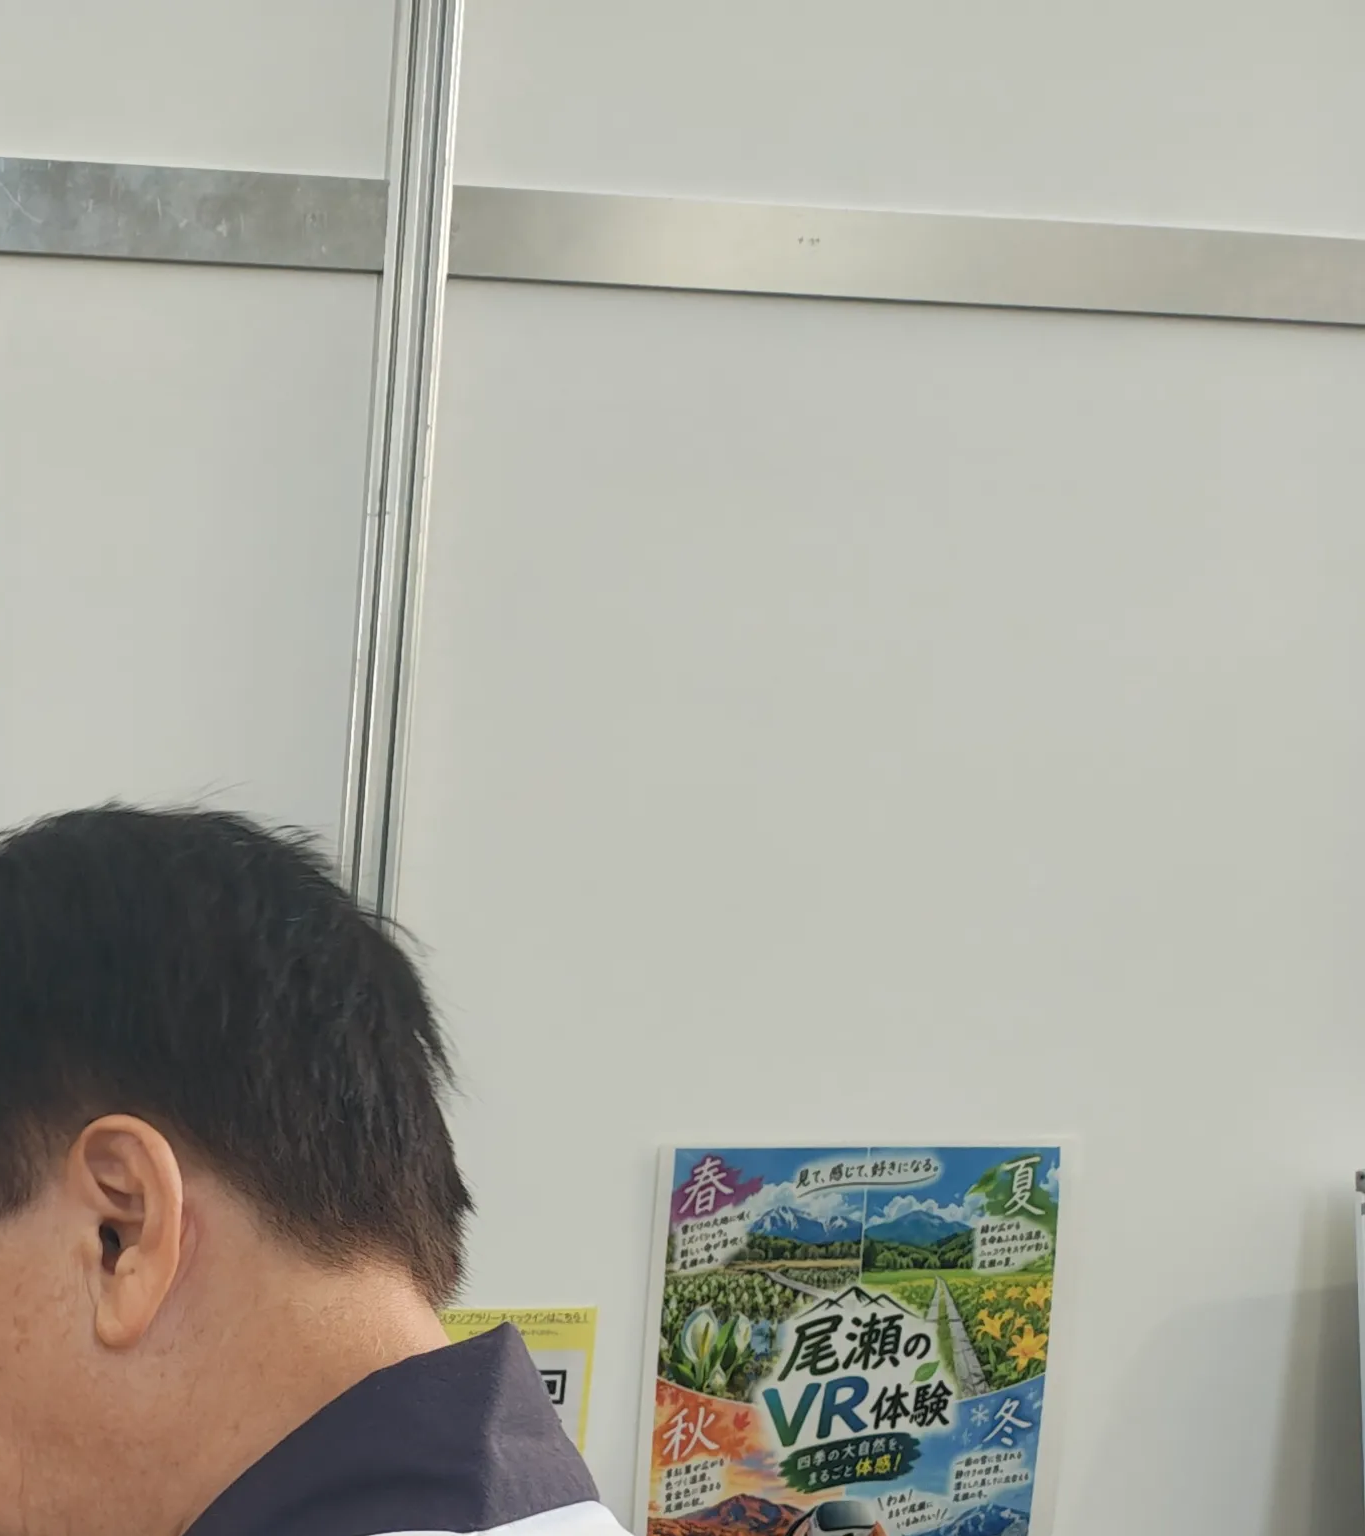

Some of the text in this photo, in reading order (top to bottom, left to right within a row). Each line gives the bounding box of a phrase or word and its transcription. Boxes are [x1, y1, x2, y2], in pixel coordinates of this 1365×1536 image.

[679, 1157, 734, 1215] 春
[1005, 1155, 1045, 1216] 夏
[778, 1313, 931, 1381] 尾瀬の
[662, 1407, 720, 1461] 秋
[982, 1397, 1031, 1446] 冬
